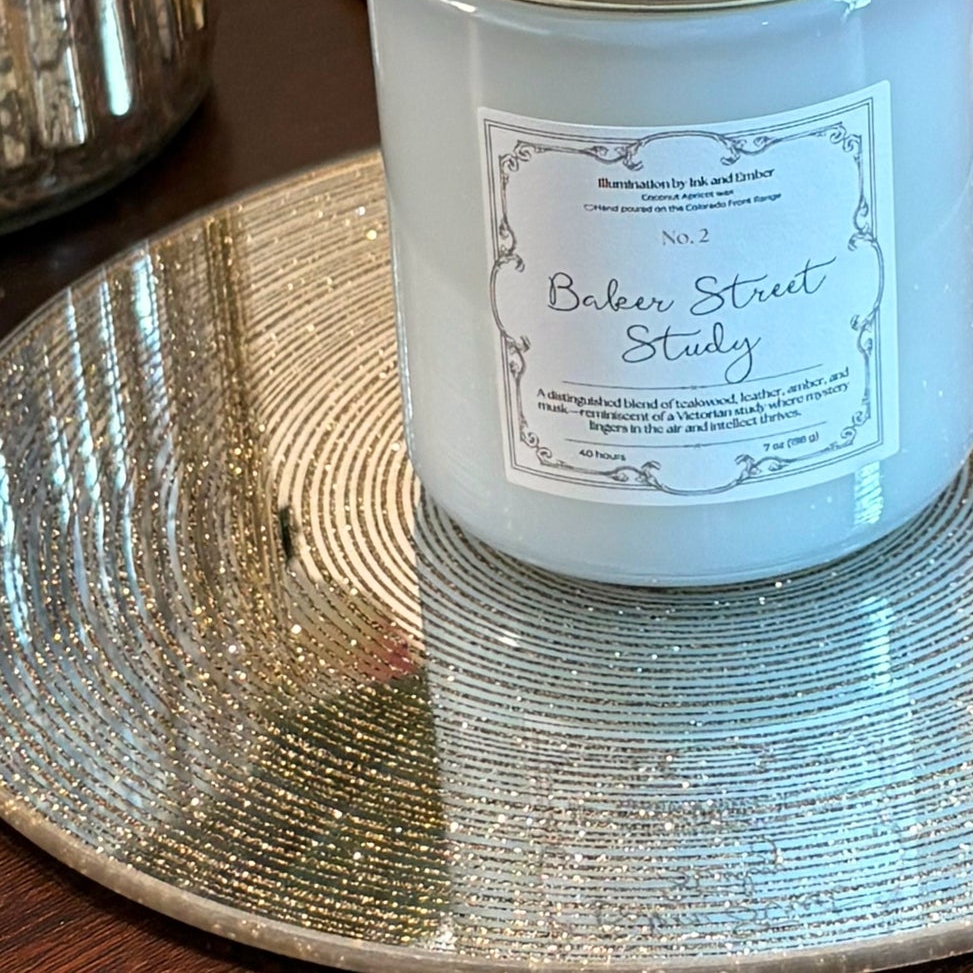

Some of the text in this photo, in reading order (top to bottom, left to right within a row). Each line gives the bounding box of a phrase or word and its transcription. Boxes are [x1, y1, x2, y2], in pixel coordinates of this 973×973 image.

[598, 168, 775, 191] Illumination by Ink and Ember
[620, 205, 653, 214] poured
[669, 203, 684, 213] the
[685, 201, 727, 212] Colorado
[661, 228, 710, 246] No. 2
[547, 256, 837, 316] Baker Street
[621, 322, 761, 385] Study
[537, 388, 545, 398] A
[547, 390, 622, 409] distinguished
[623, 398, 659, 410] blend
[660, 399, 675, 409] of
[829, 366, 849, 384] and
[651, 410, 664, 421] of
[676, 407, 733, 421] Victorian
[769, 395, 804, 411] where
[589, 410, 802, 436] lingers in the air and intellect thrives.
[579, 449, 626, 461] 40 hours
